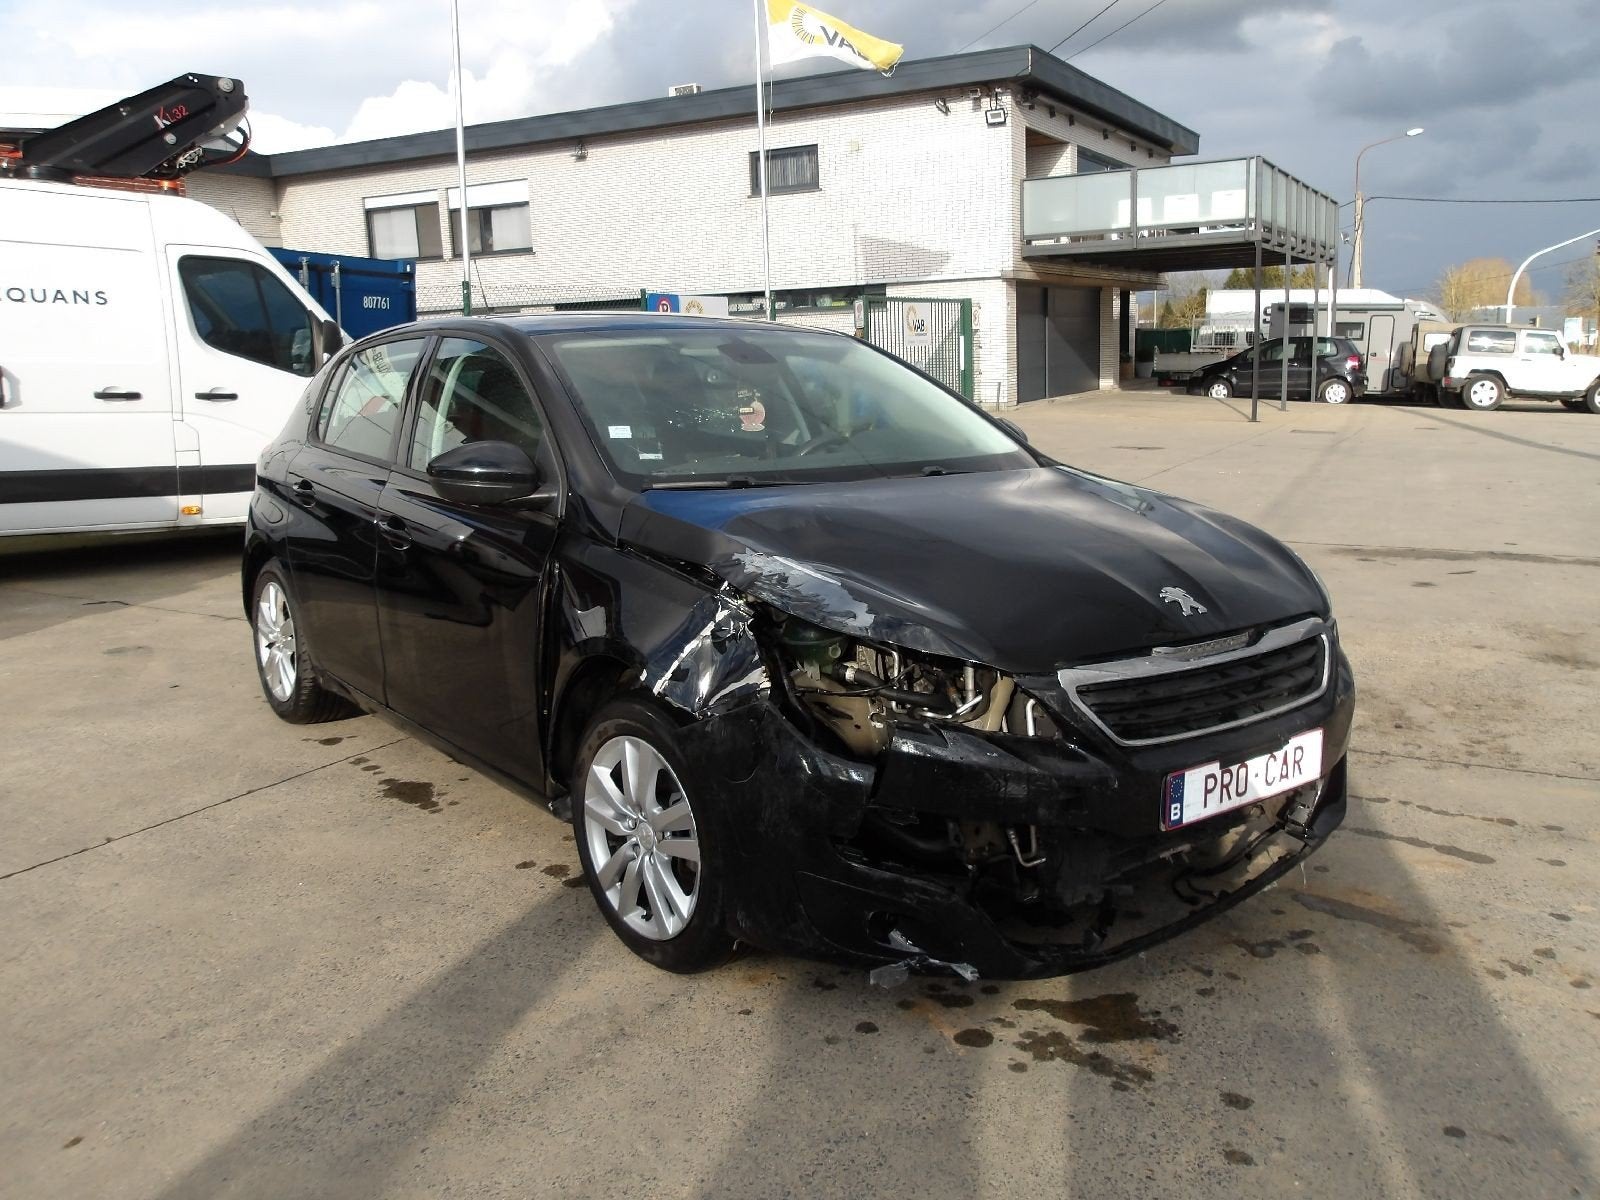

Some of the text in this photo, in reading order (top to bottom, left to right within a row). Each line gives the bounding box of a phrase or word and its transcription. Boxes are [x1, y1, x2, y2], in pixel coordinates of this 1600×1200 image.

[820, 25, 869, 61] VA
[0, 287, 108, 305] QUANS
[363, 296, 390, 310] 807761
[1204, 762, 1249, 809] PRO
[1265, 745, 1304, 786] CAR
[1170, 803, 1181, 821] B
